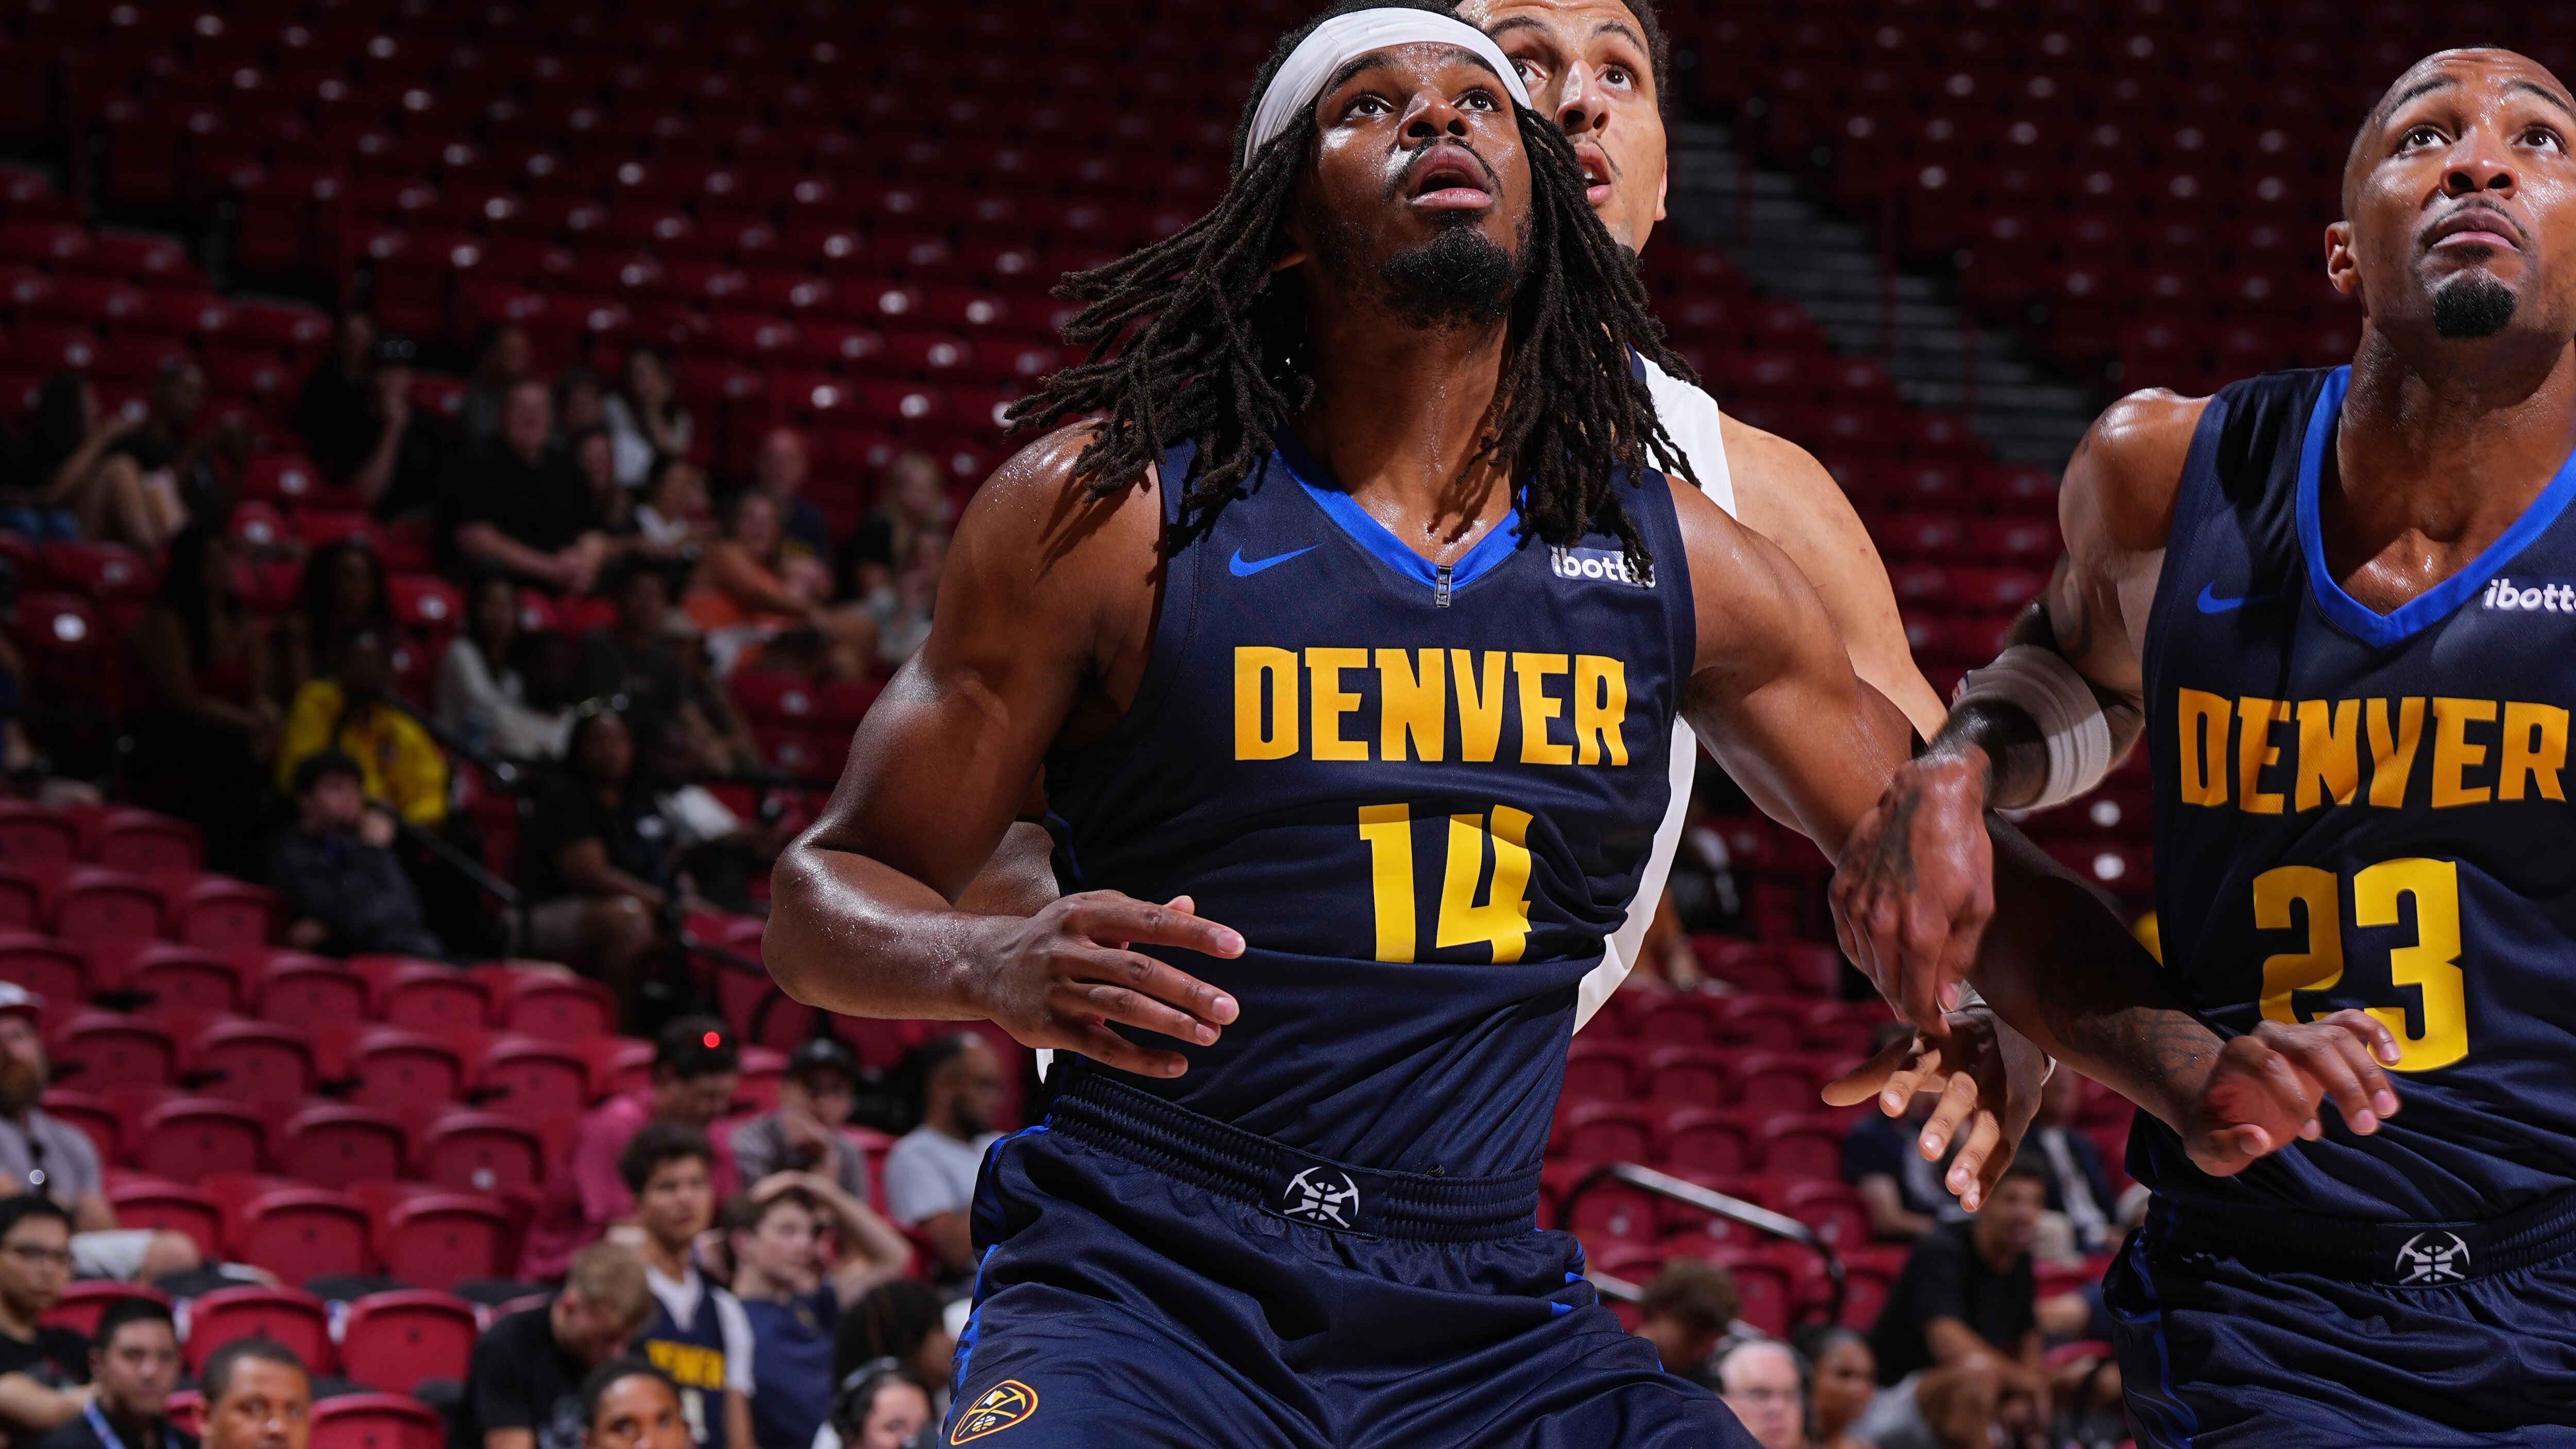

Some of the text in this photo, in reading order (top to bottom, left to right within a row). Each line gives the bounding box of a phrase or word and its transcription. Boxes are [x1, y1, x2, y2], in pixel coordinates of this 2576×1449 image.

[2485, 578, 2576, 613] ibott
[1234, 646, 1629, 765] DENVER
[2178, 687, 2569, 814] DENVER
[1359, 803, 1534, 963] 14
[2252, 857, 2469, 1073] 23
